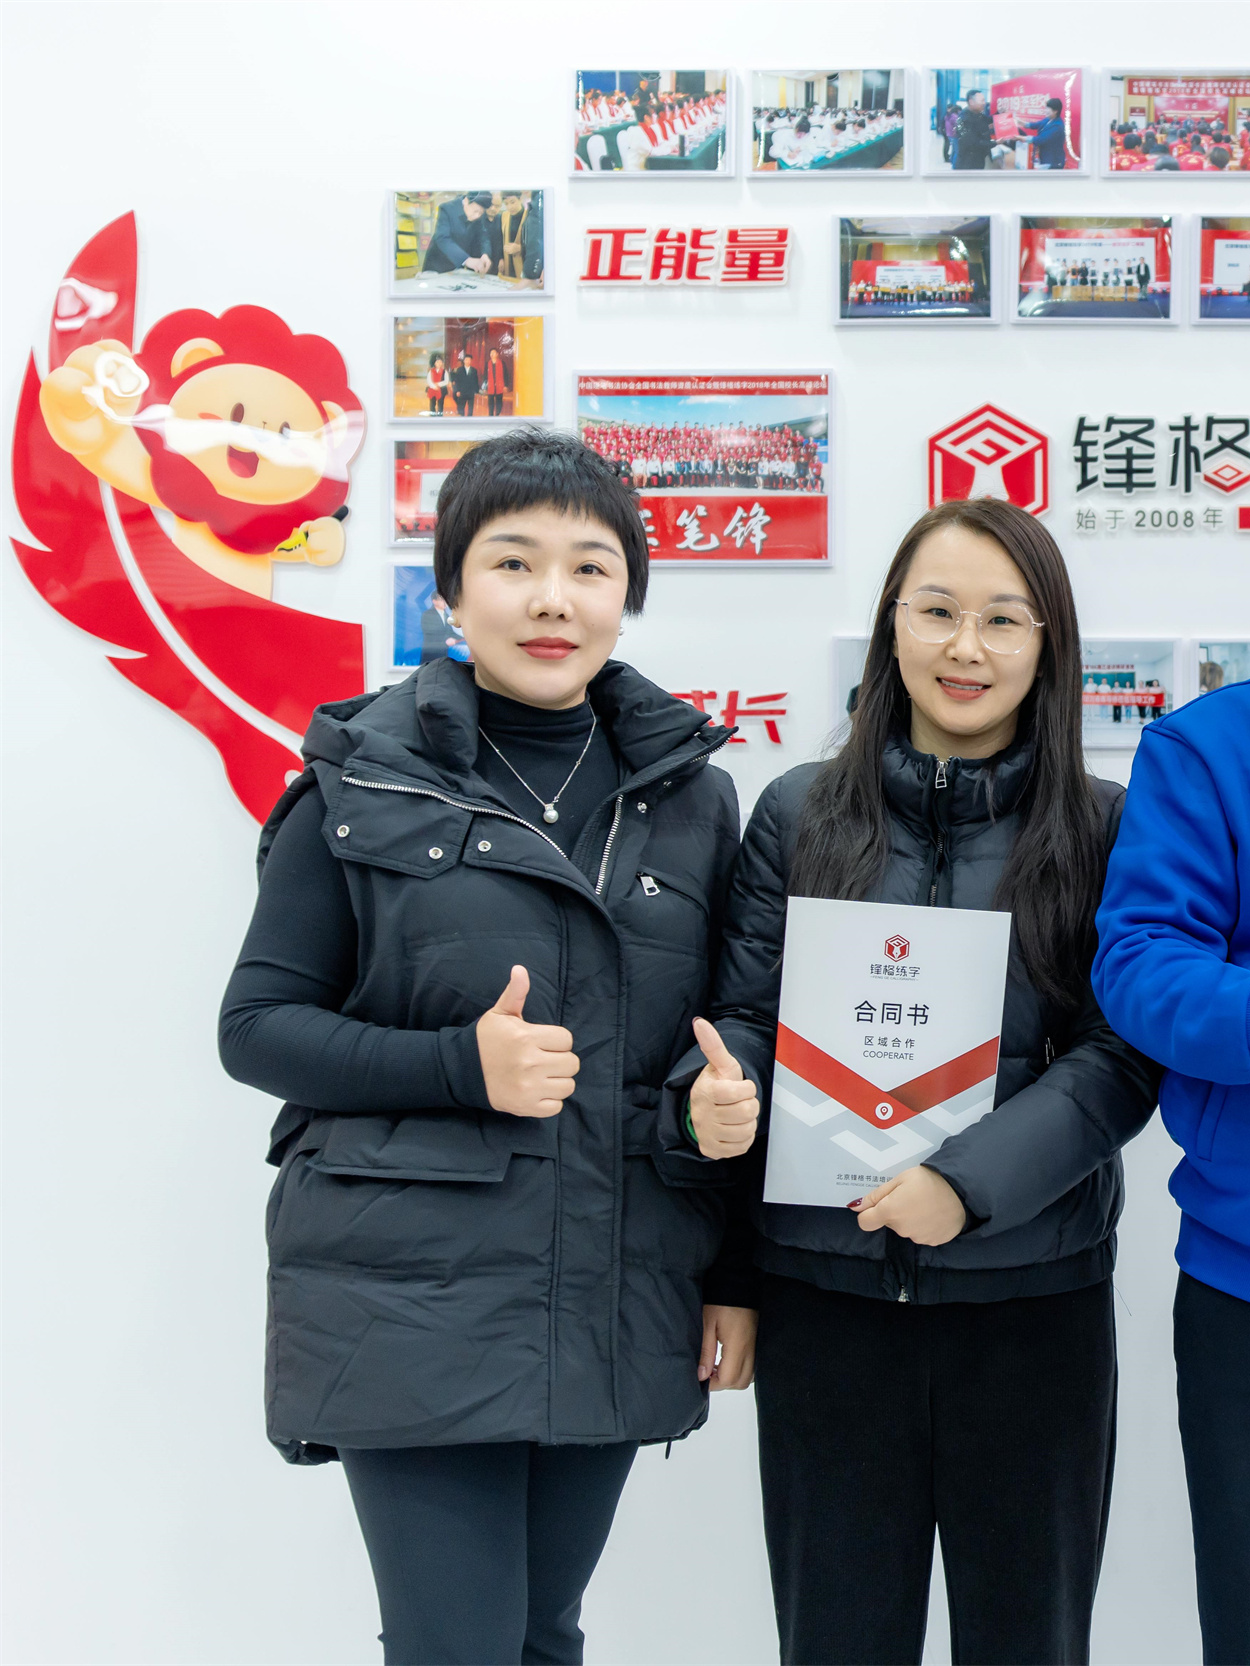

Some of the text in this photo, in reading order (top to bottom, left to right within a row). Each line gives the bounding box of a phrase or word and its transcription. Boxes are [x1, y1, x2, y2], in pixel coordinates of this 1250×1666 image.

[580, 227, 789, 283] 正能量
[1076, 507, 1223, 530] 始于2008年
[870, 963, 921, 978] 锋格练字
[854, 1000, 930, 1027] 合同书
[864, 1036, 915, 1049] 区域合作
[863, 1050, 914, 1061] COOPERATE
